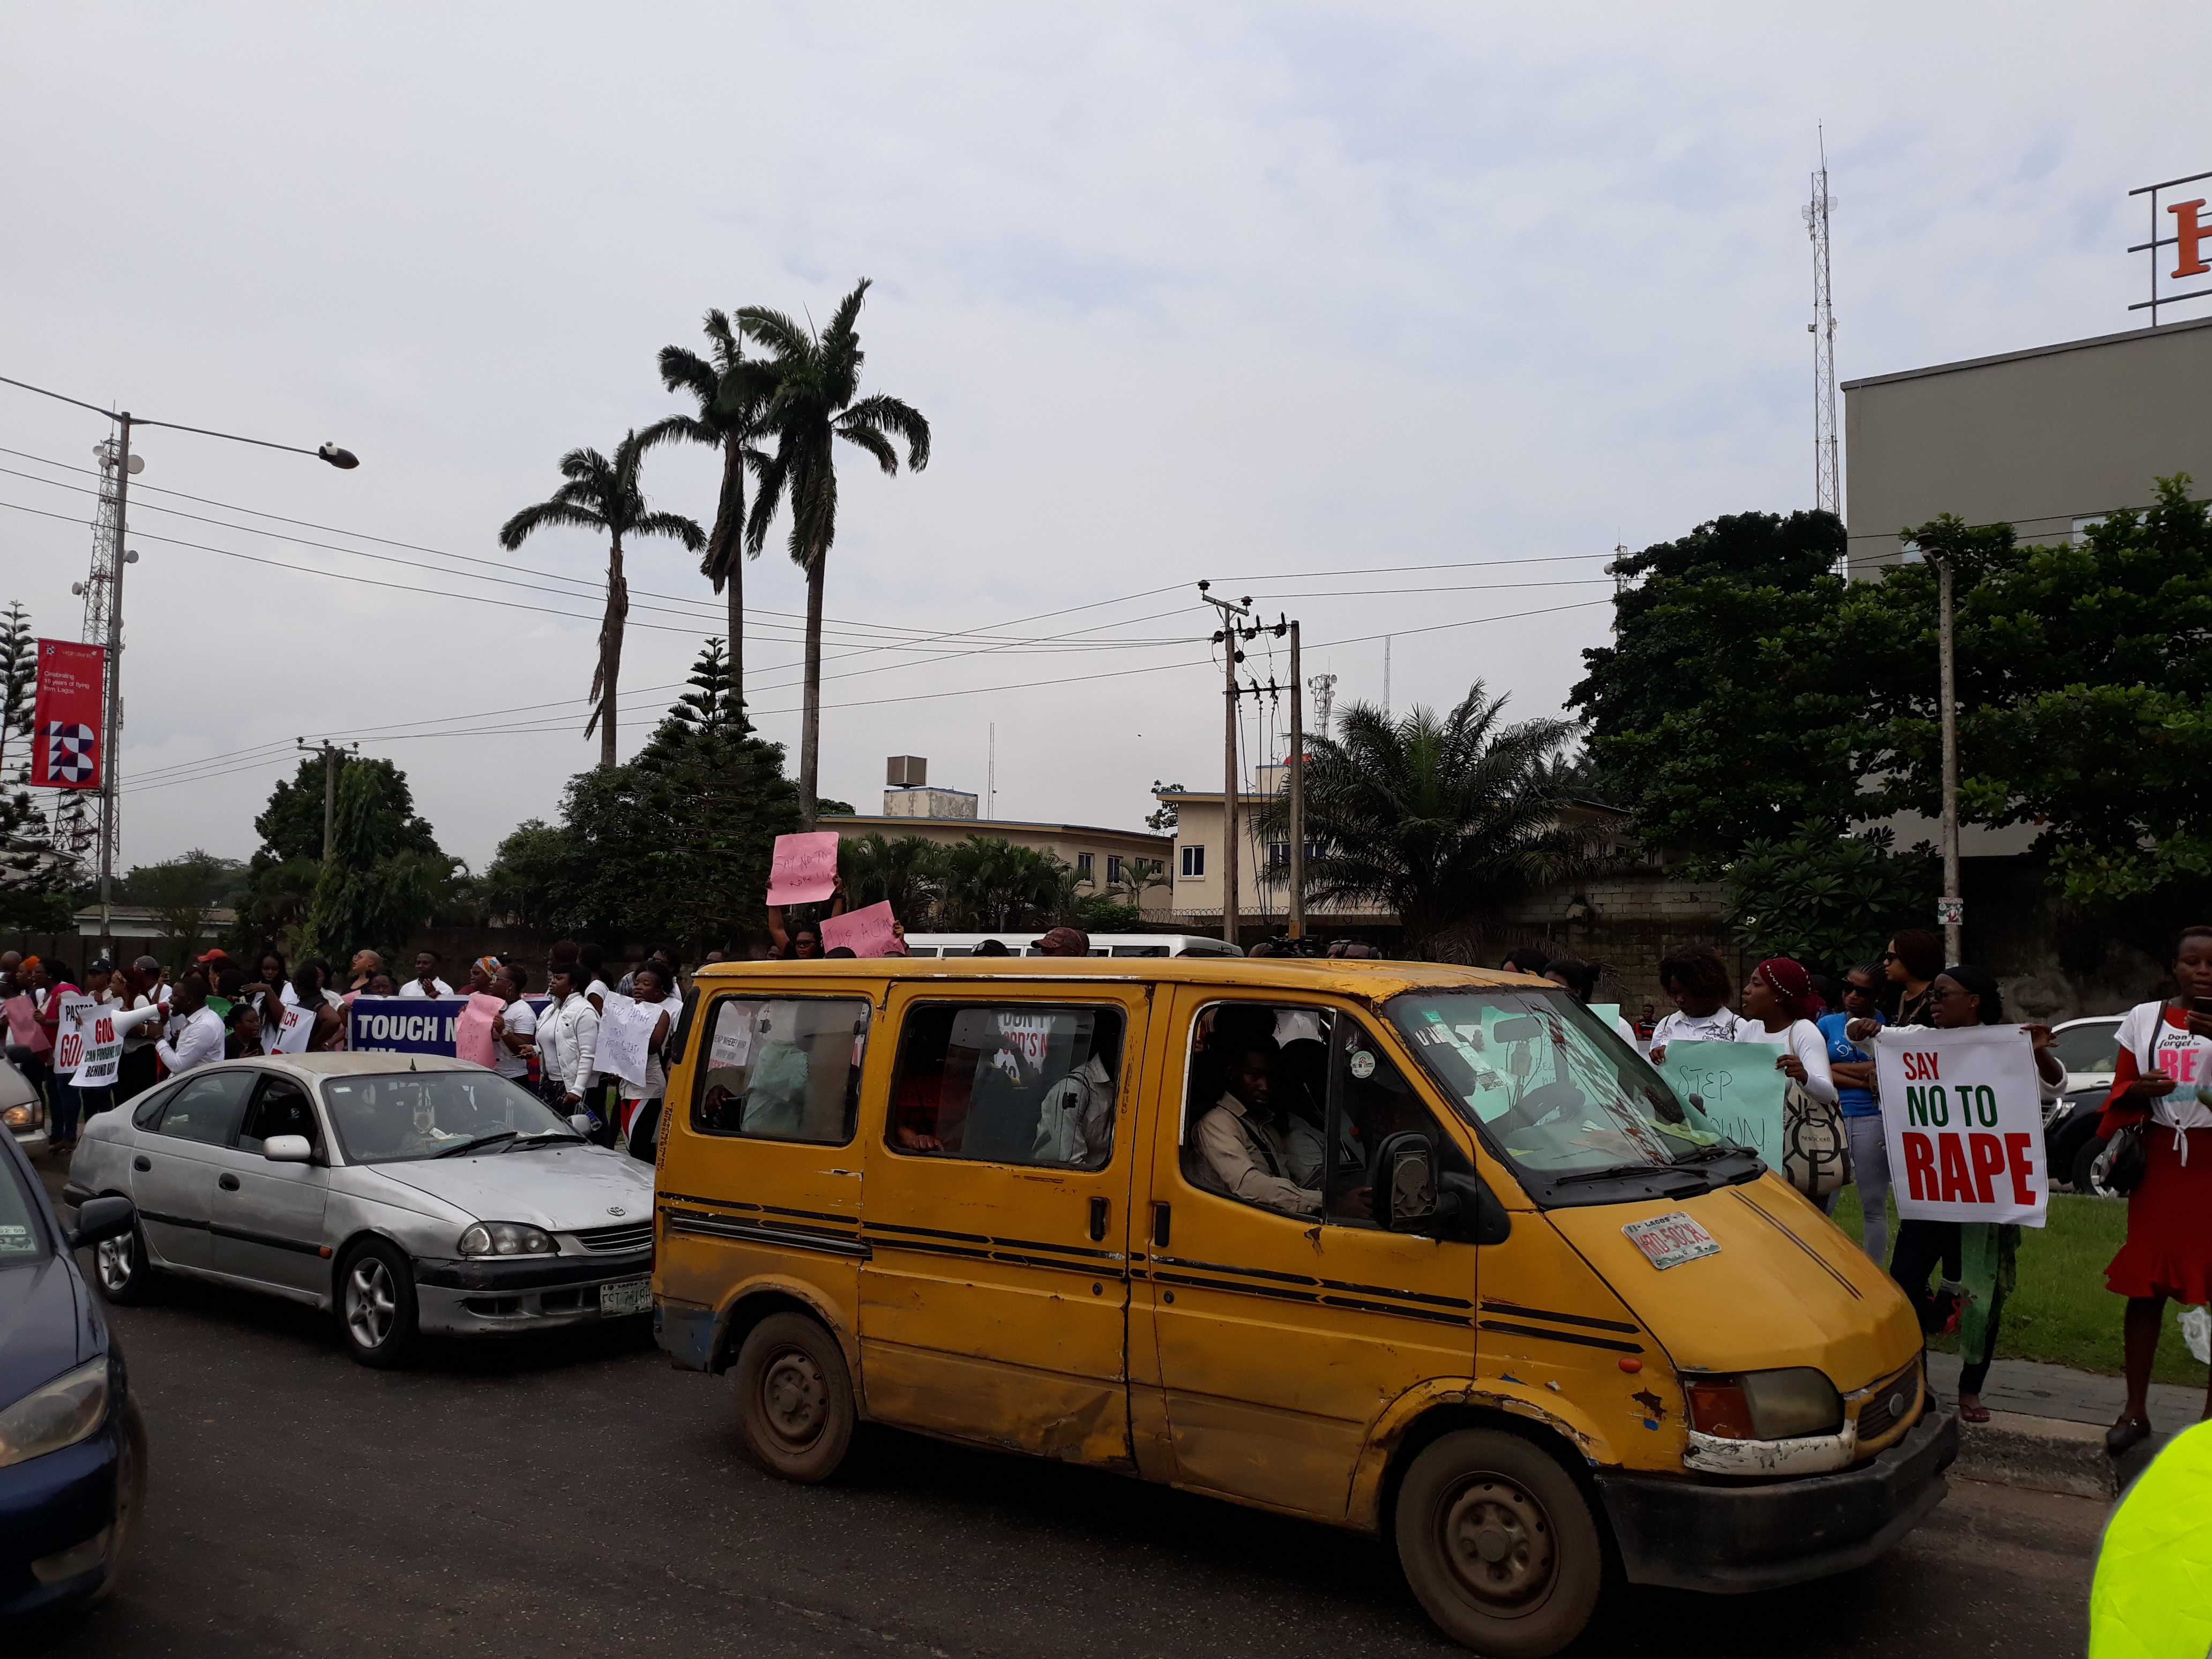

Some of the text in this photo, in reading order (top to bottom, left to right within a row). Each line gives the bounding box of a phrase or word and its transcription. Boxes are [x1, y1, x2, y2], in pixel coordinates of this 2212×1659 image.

[57, 686, 74, 694] Lagos
[357, 1015, 439, 1042] TOUCH
[2157, 1040, 2191, 1050] forget
[85, 1063, 107, 1078] BEHIND
[1902, 1052, 1939, 1080] SAY
[2158, 1049, 2200, 1082] BE
[1678, 1065, 1732, 1101] STEP
[1906, 1085, 1998, 1127] NO TO
[1902, 1132, 2036, 1206] RAPE
[1644, 1216, 1671, 1227] LAGOS
